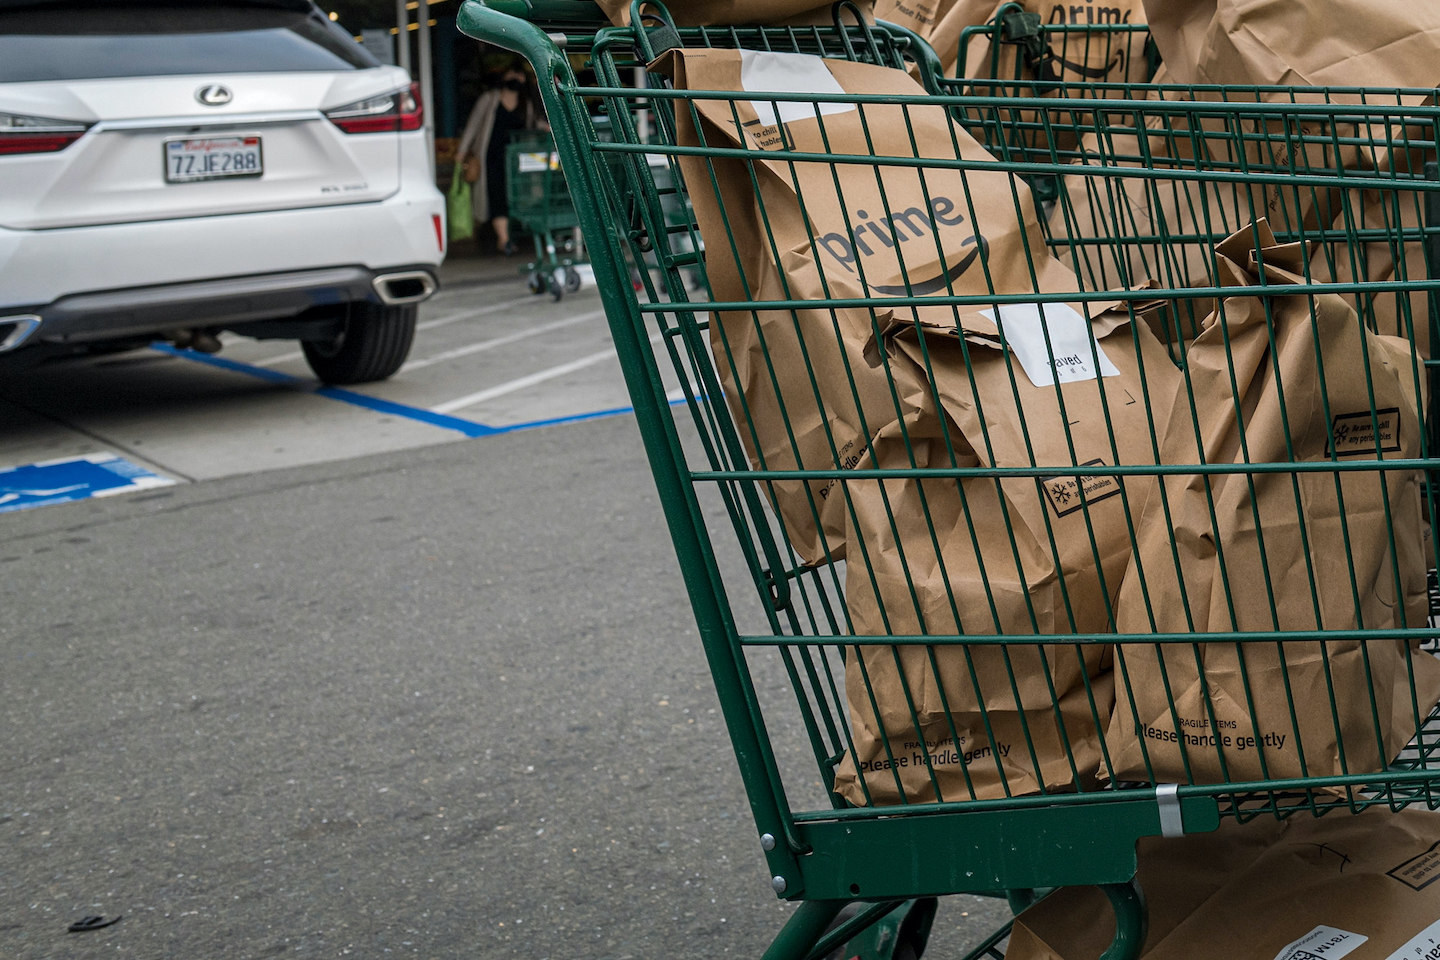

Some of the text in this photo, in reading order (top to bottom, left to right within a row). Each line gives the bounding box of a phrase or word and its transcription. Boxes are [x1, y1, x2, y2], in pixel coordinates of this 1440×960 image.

[762, 126, 778, 136] chill
[818, 197, 964, 273] prime
[1047, 354, 1082, 368] aved
[1178, 717, 1237, 729] RAGILE TEMS
[964, 741, 1011, 766] genly
[1314, 934, 1349, 954] 781M
